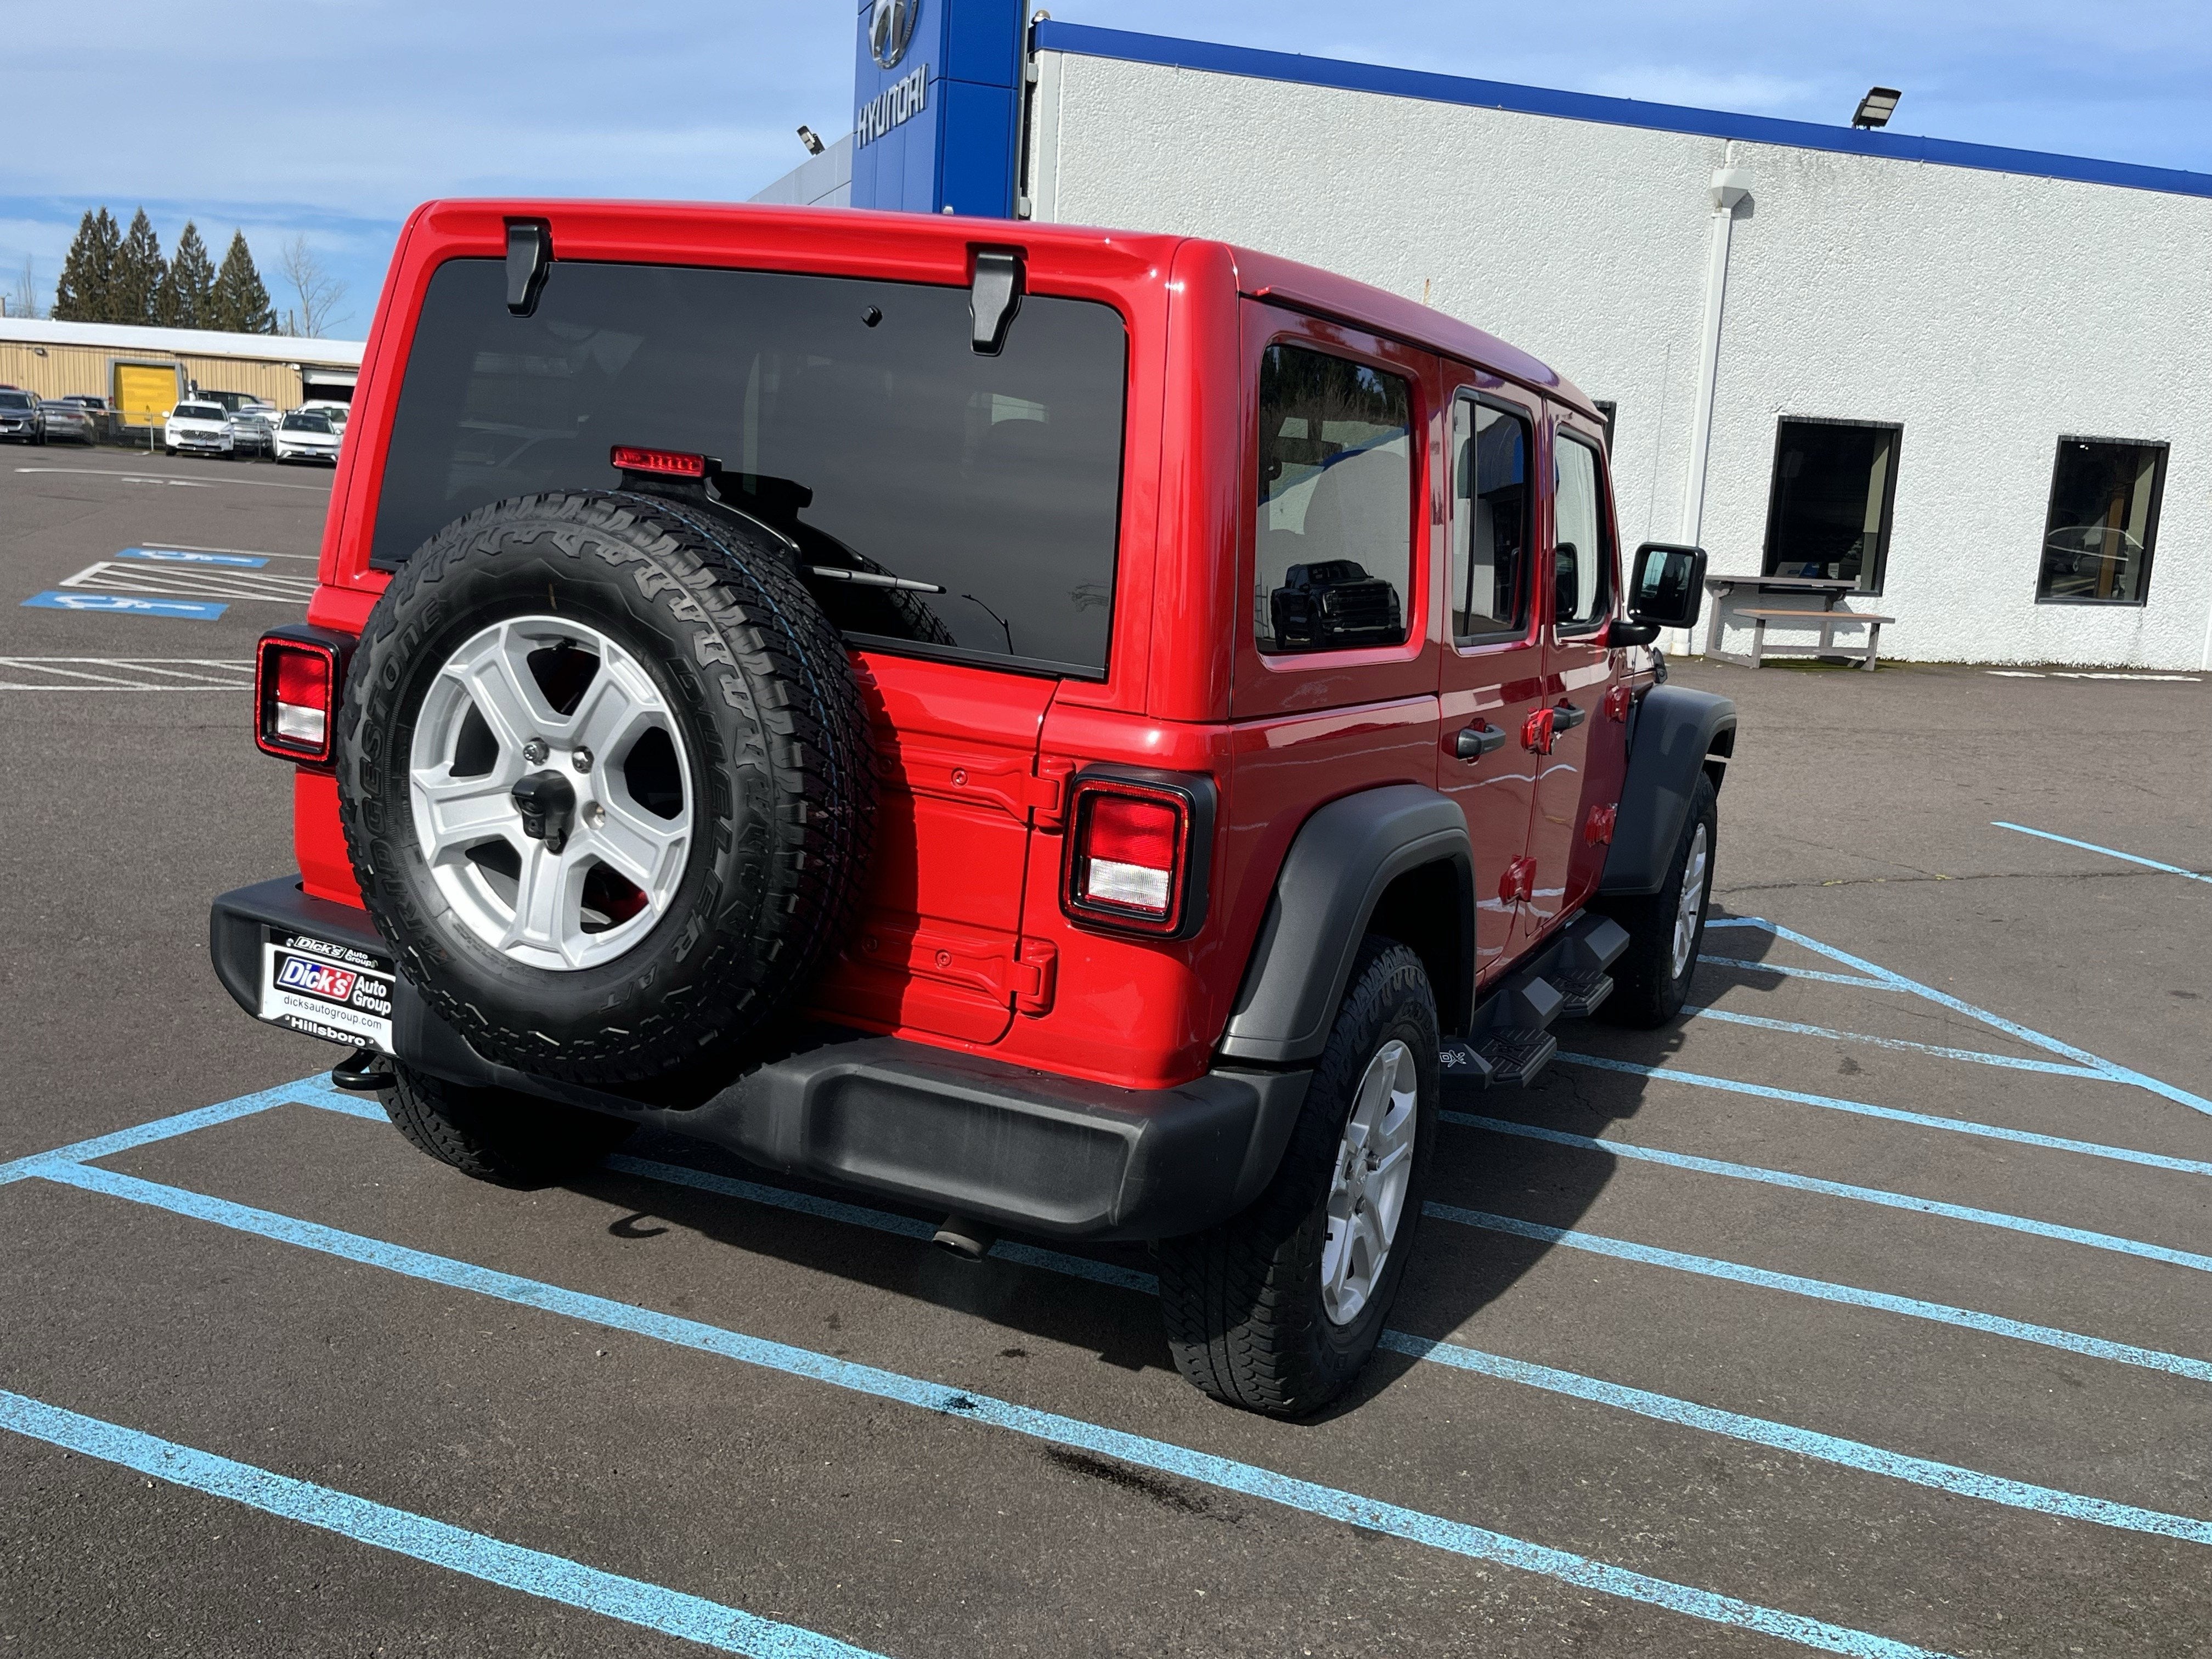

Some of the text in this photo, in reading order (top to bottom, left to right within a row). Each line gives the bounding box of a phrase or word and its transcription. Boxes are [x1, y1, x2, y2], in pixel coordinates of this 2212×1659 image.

[857, 63, 928, 149] HYUNDAI
[665, 654, 734, 962] DUELER
[297, 937, 343, 957] Dick's
[345, 953, 373, 967] Group
[347, 949, 368, 960] Auto
[283, 961, 349, 996] Dick's
[355, 976, 387, 996] Auto
[284, 995, 382, 1030] dicksautogroup.com
[352, 991, 392, 1014] Group
[291, 1016, 365, 1046] Hillsboro
